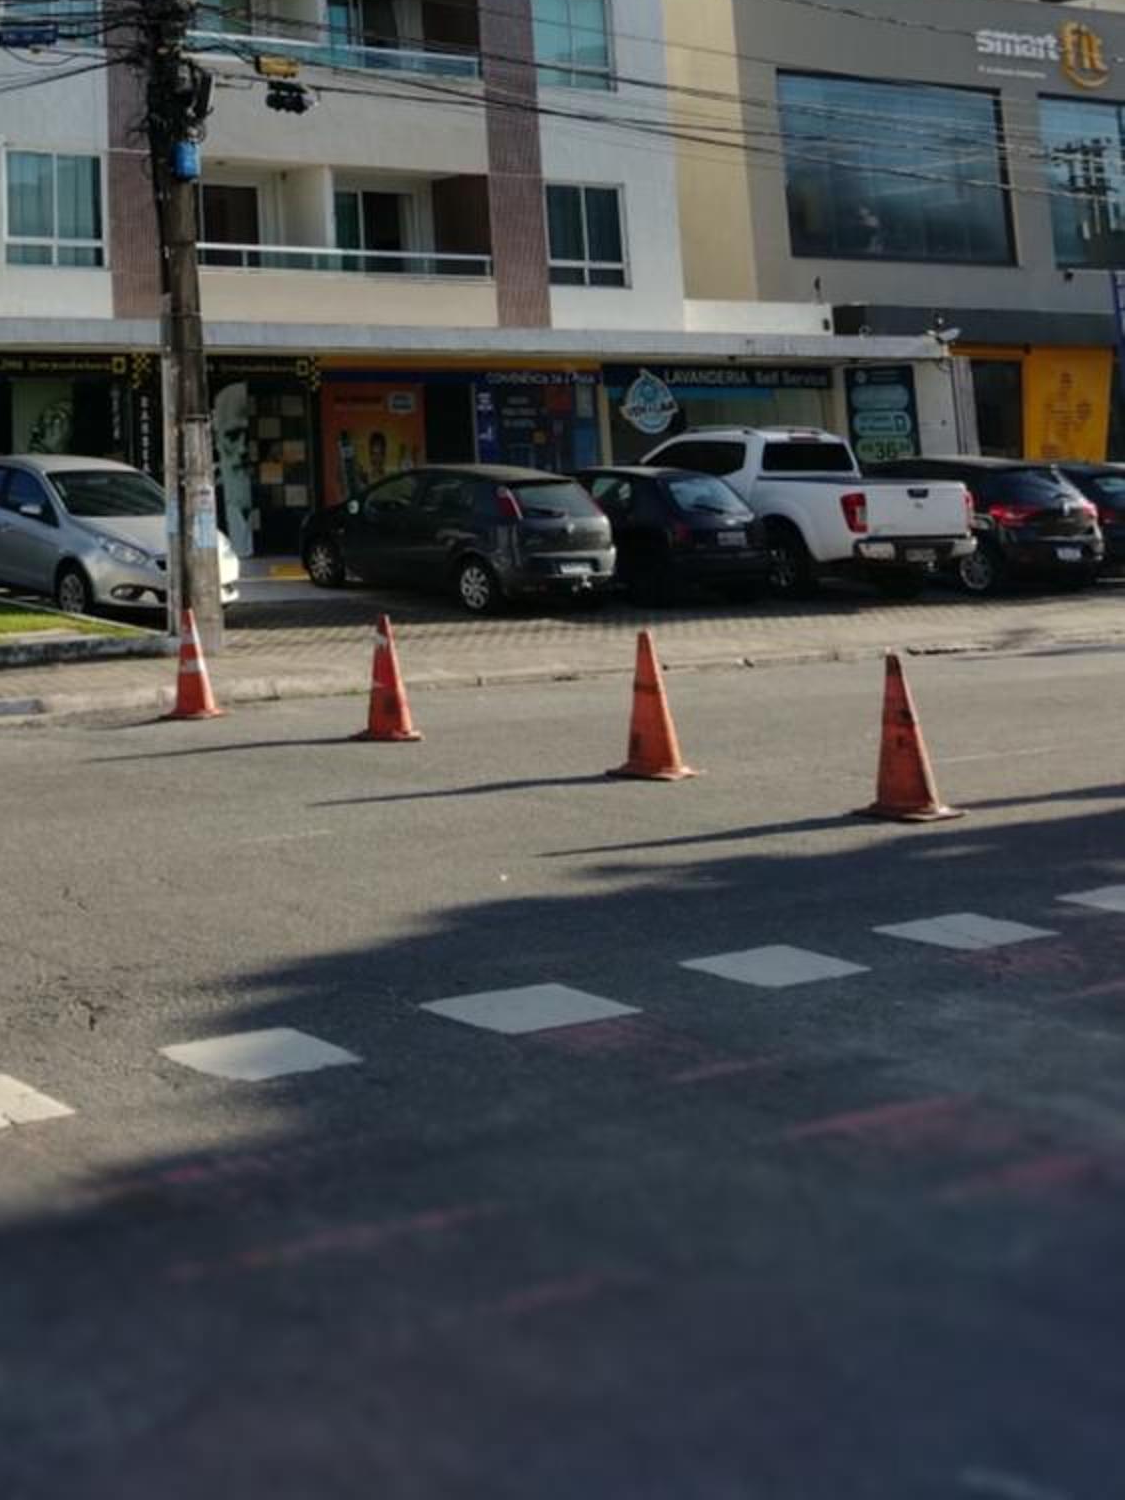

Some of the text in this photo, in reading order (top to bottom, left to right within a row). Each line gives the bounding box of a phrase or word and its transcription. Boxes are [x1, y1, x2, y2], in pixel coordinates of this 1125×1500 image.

[975, 20, 1108, 82] smart fit
[665, 370, 749, 385] LAVANDERIA
